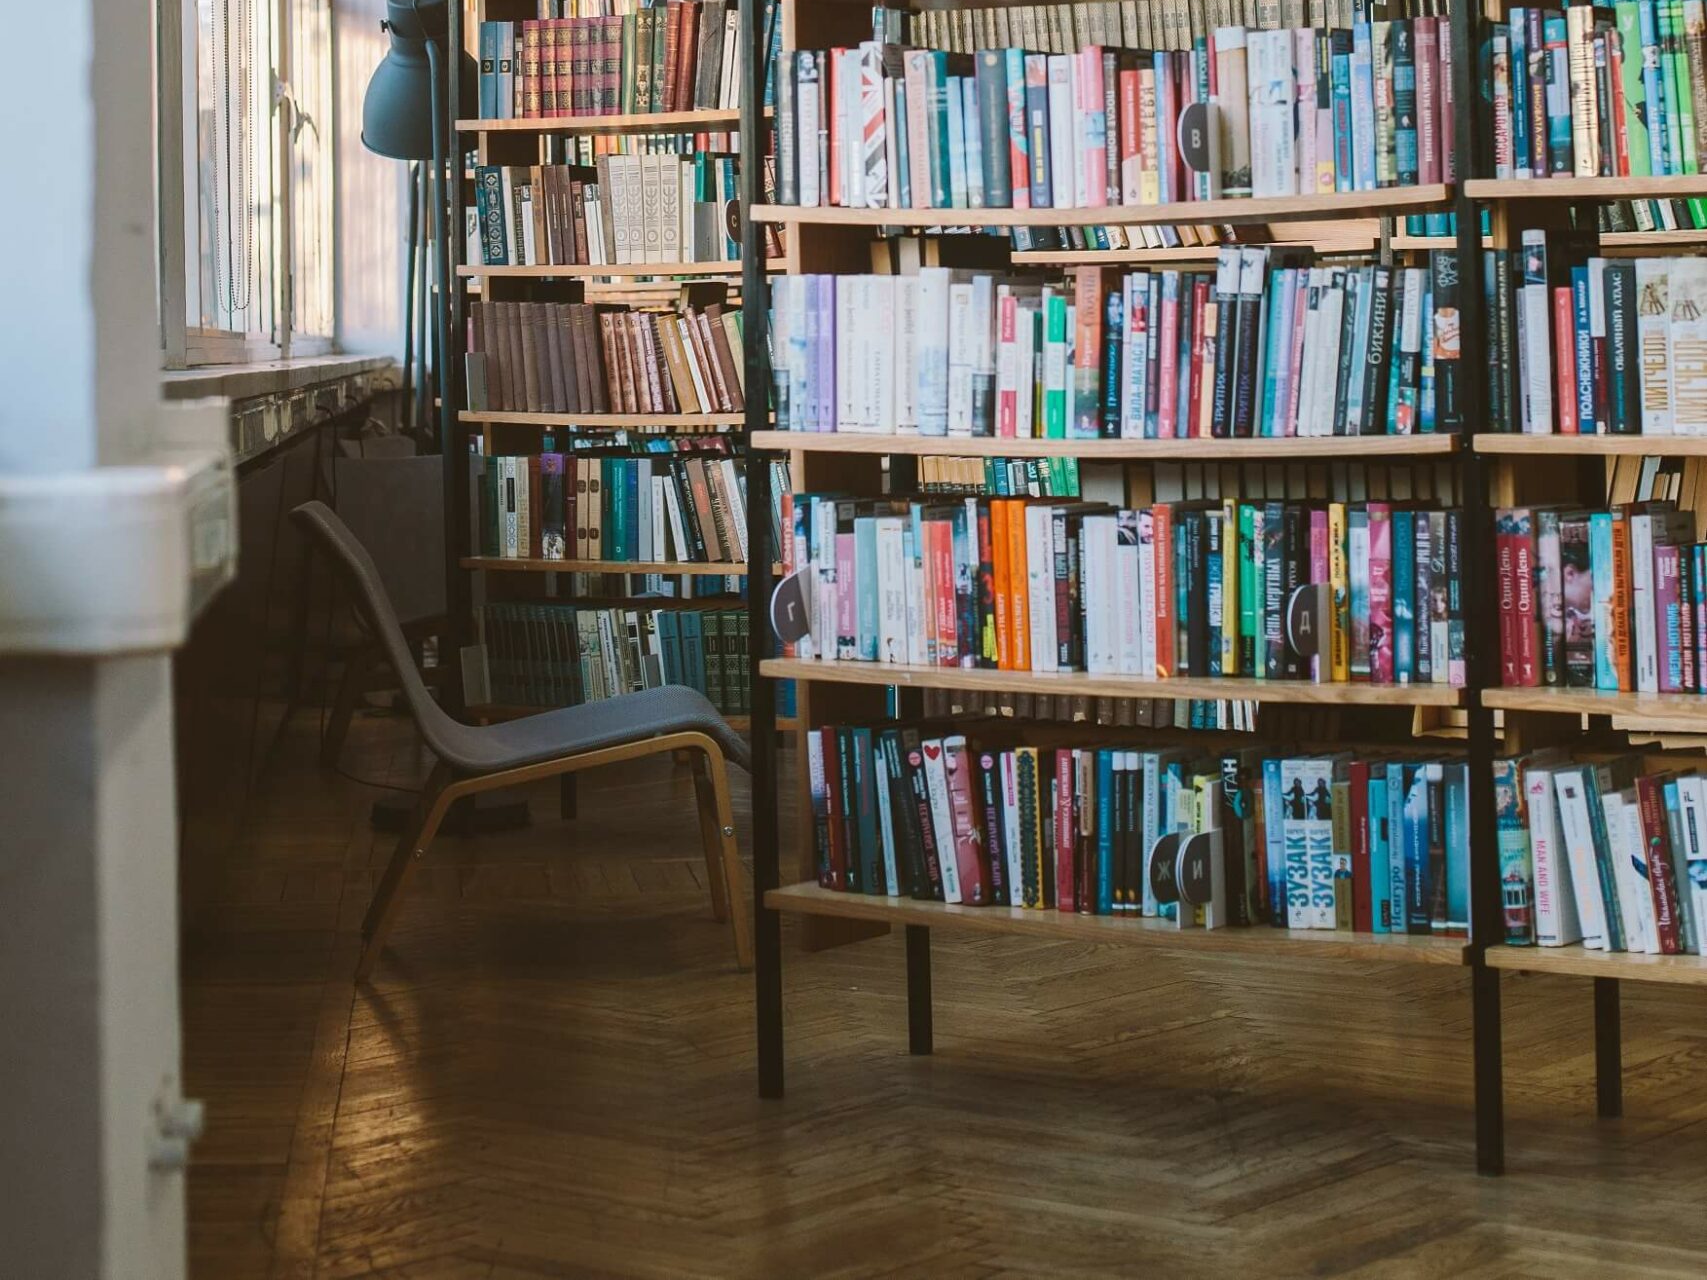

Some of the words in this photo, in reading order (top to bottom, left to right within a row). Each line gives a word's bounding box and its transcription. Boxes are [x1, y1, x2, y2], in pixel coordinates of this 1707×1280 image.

[1422, 62, 1432, 108] МАЛЬЧИК
[1106, 90, 1116, 127] ПОСЛЕ
[1144, 86, 1155, 129] ТЕБЯ
[1532, 84, 1542, 133] ВИНОВАТА
[1107, 130, 1117, 170] ВОЙНЫ
[1192, 129, 1200, 148] В
[1424, 108, 1434, 162] НЕМЕЦКИЙ
[1535, 134, 1544, 161] ЛОЖЬ
[1578, 280, 1586, 308] МИЛЛЕР
[1612, 272, 1622, 308] АТЛАС
[1612, 310, 1624, 370] ОБЛАЧНЫЙ
[1131, 348, 1142, 420] ВИЛА-МАТАС
[1578, 329, 1592, 420] ПОДСНЕЖНИКИ
[1644, 336, 1668, 411] МИТЧЕЛЛ
[1215, 372, 1227, 422] ТРИПТИХ
[1238, 373, 1250, 423] ТРИПТИХ
[1143, 550, 1152, 584] ТЬМЫ
[1500, 548, 1512, 576] День
[1517, 548, 1529, 578] День
[1614, 550, 1624, 578] РОЖАЛИ
[1265, 558, 1284, 610] мертвых
[1501, 577, 1512, 610] Один
[1518, 578, 1530, 612] Один
[787, 602, 795, 622] Г
[1144, 589, 1154, 644] ОБЛАСТИ
[1264, 614, 1281, 642] День
[1299, 611, 1311, 634] Д
[1617, 610, 1626, 637] ДЕЛАЛА,
[1666, 604, 1679, 647] НОТОМБ
[1681, 604, 1692, 647] НОТОМБ
[1668, 650, 1680, 688] АМЕЛИ
[1682, 650, 1694, 688] АМЕЛИ
[1223, 759, 1238, 807] ИГАН
[1100, 798, 1108, 839] КОМНАТА
[1158, 861, 1171, 880] Ж
[1193, 860, 1202, 880] И
[1535, 840, 1546, 864] MAN
[1286, 836, 1309, 908] ЗУЗАК
[1310, 836, 1333, 908] ЗУЗАК
[1537, 865, 1548, 886] AND
[1390, 866, 1406, 927] Исигуро
[1538, 890, 1550, 915] WIFE
